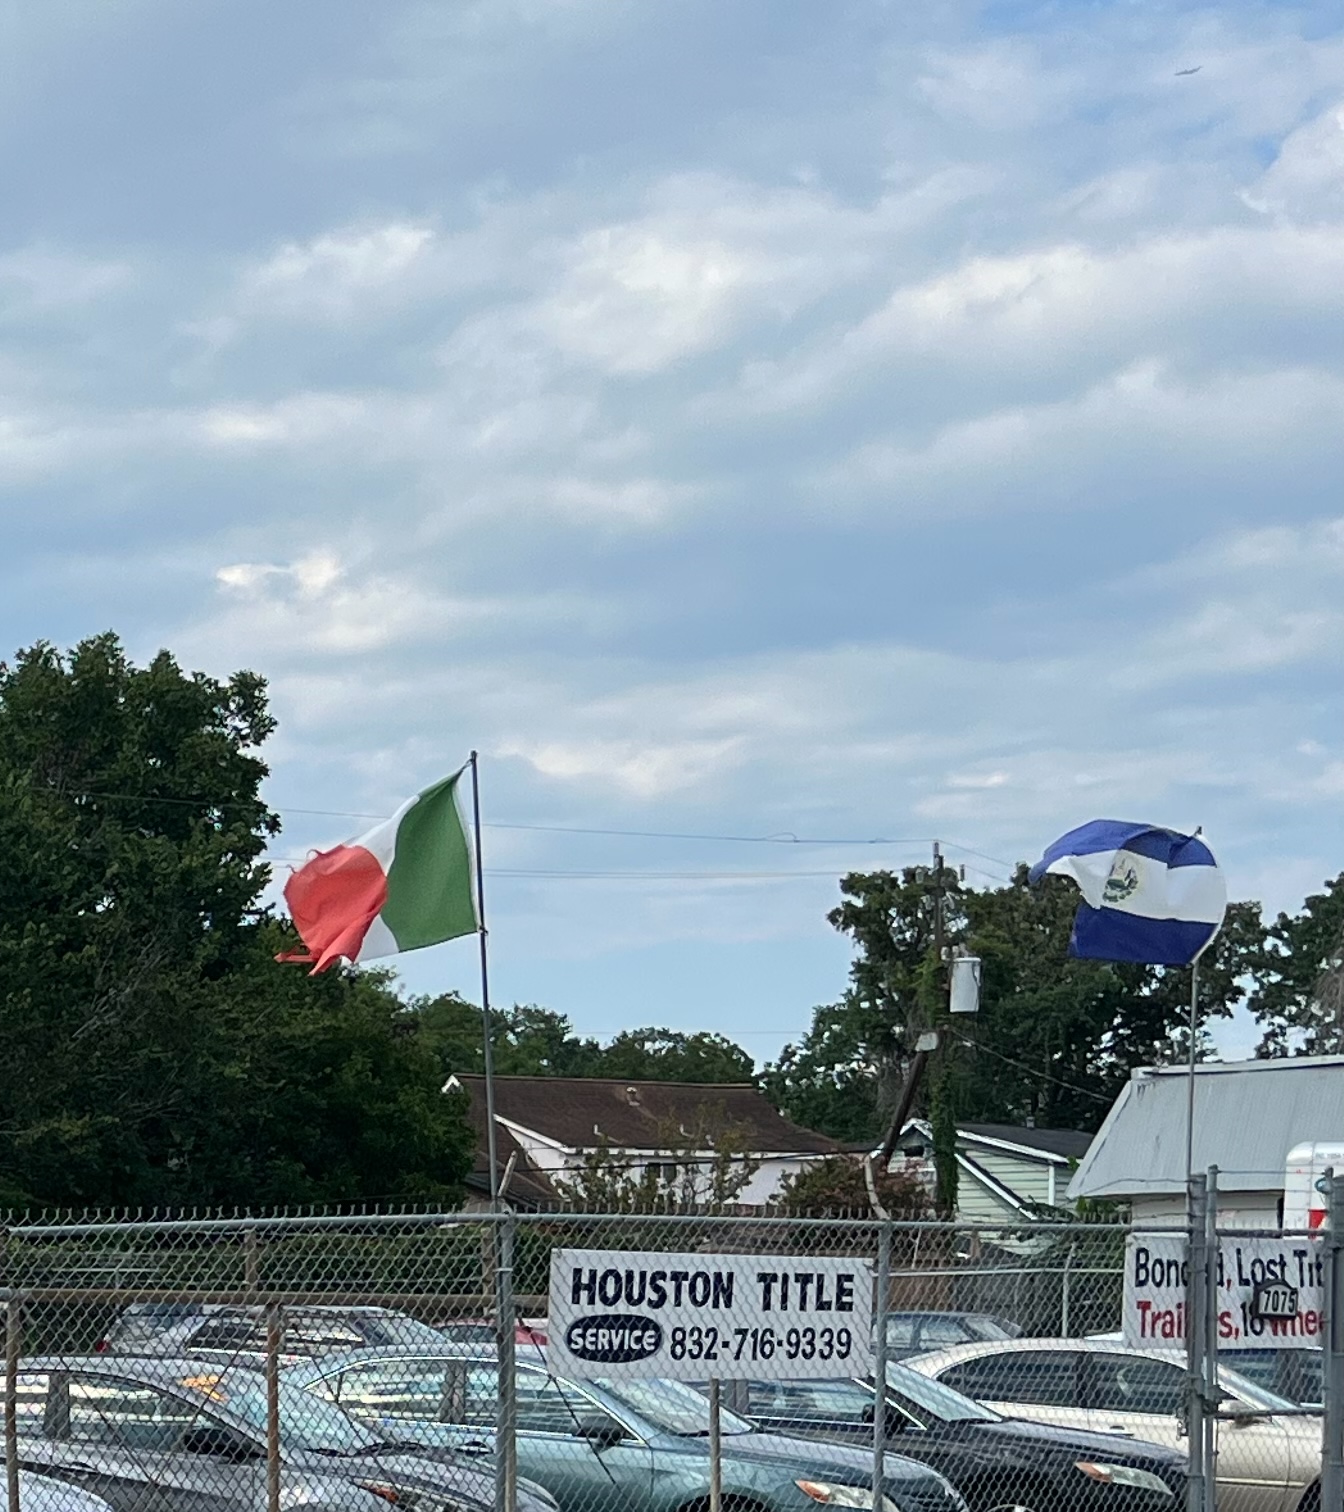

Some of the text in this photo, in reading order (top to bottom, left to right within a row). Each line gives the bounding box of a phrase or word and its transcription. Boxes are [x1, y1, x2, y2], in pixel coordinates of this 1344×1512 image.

[1236, 1247, 1287, 1287] Lost
[570, 1267, 855, 1312] HOUSTON TITLE
[1264, 1290, 1297, 1313] 7075
[570, 1325, 853, 1361] SERVICE 832-716-9339
